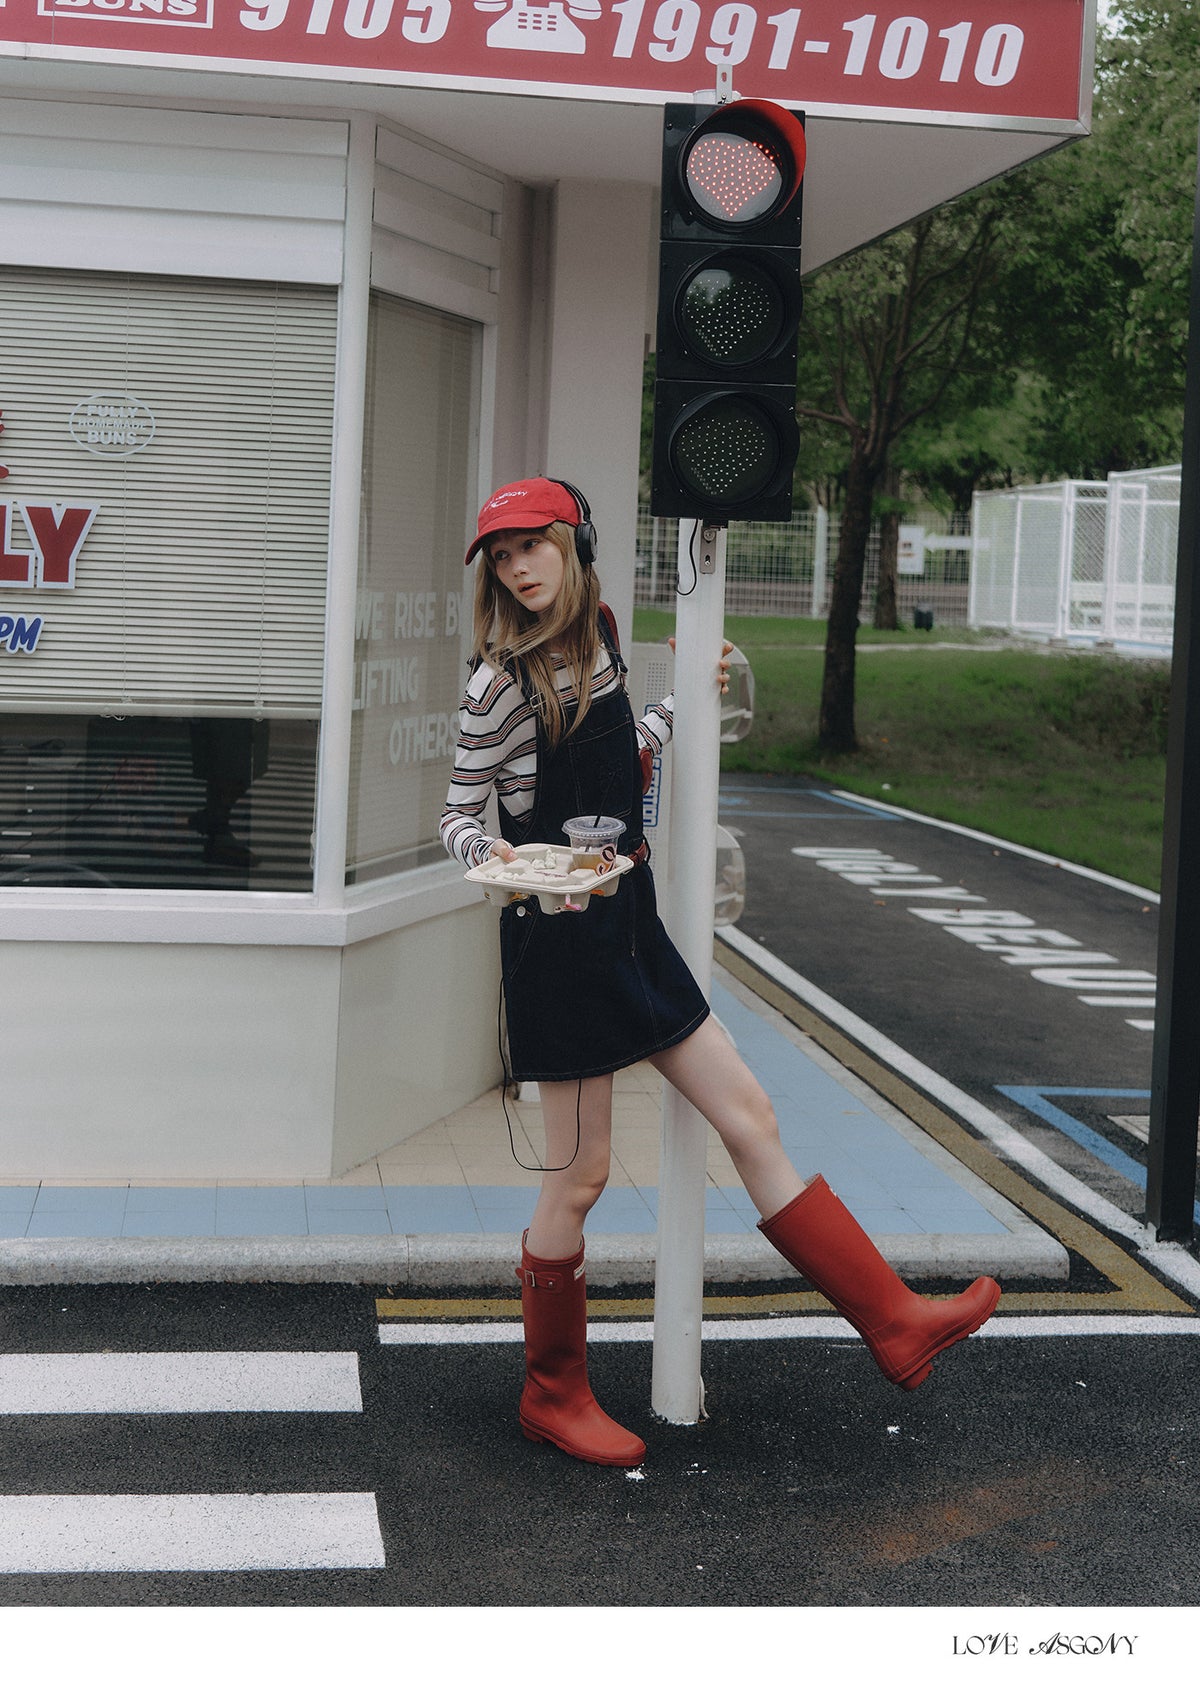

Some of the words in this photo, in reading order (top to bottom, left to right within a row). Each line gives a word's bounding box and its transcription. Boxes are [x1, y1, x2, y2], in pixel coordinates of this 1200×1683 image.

[54, 0, 198, 15] NS
[239, 0, 452, 44] 9105
[611, 0, 1025, 87] 1991-1010
[87, 430, 137, 445] BUNS
[354, 591, 386, 640] WE
[393, 591, 437, 639] RISE
[352, 656, 419, 711] LIFTING
[389, 712, 461, 765] OTHERS
[791, 847, 988, 903] UGLY
[906, 907, 1157, 1031] BEAU
